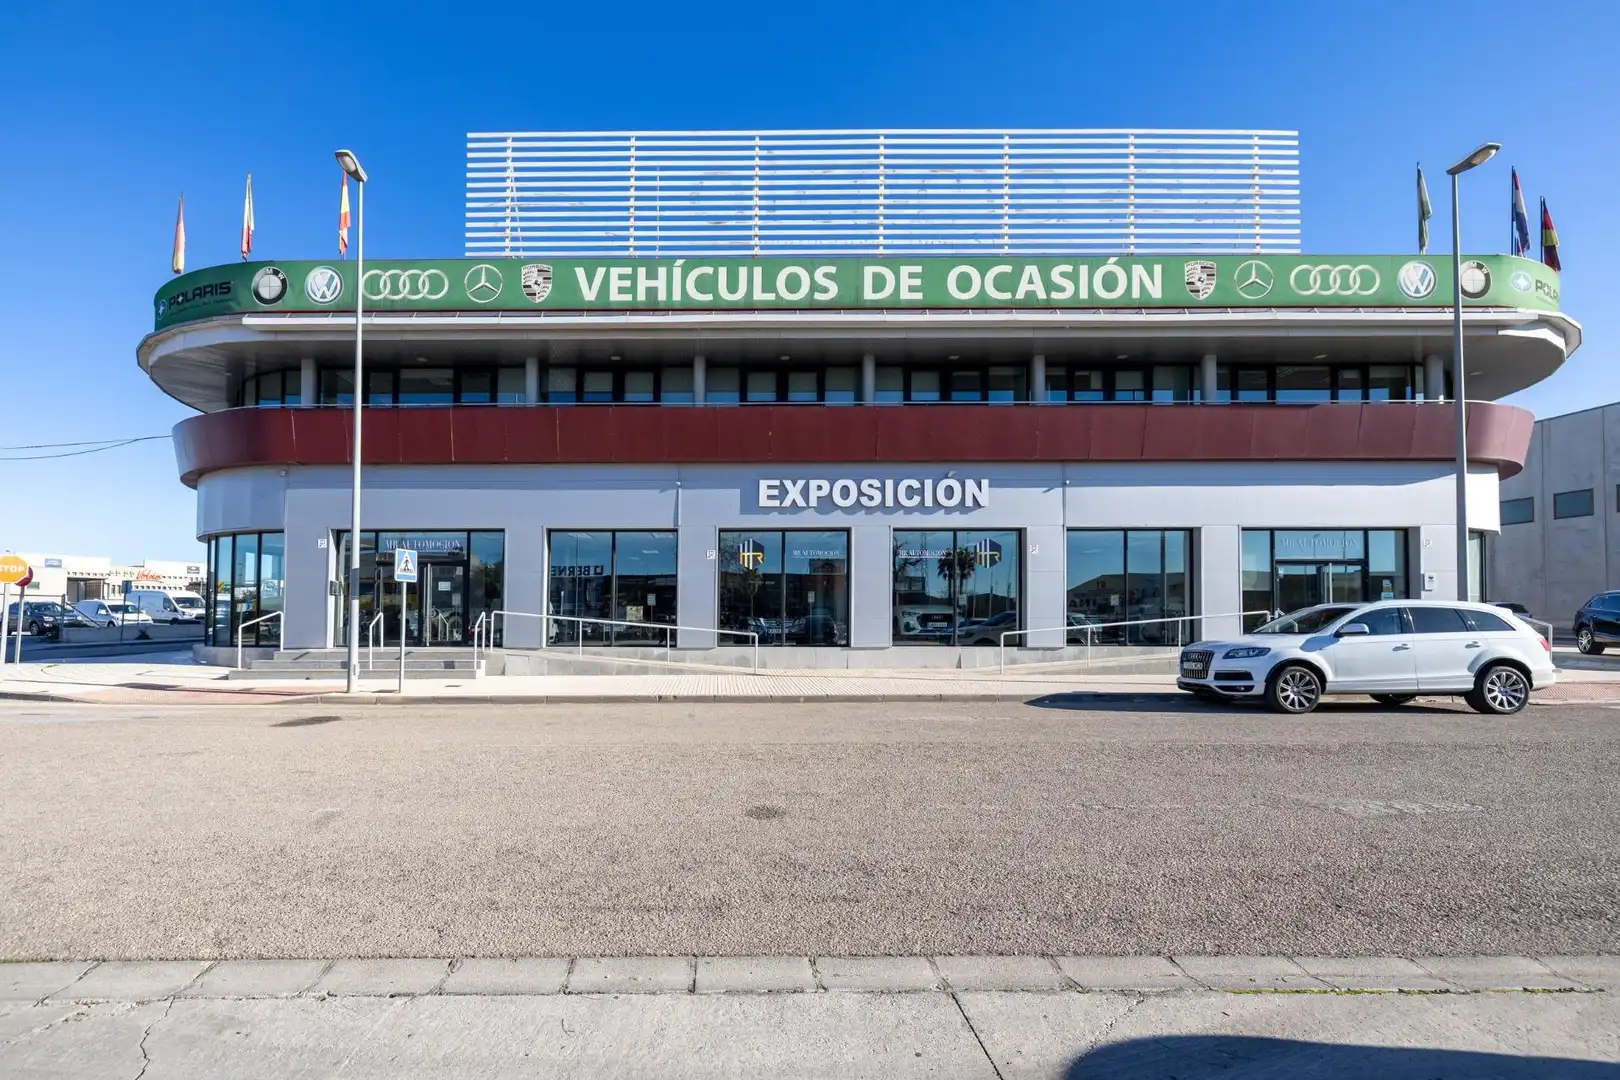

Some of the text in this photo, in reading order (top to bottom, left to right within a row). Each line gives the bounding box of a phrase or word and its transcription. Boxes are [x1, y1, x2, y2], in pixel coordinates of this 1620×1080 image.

[168, 280, 232, 310] POLARIS
[575, 257, 1163, 302] VEHÍCULOS DE OCASIÓN
[758, 470, 989, 507] EXPOSICIÓN
